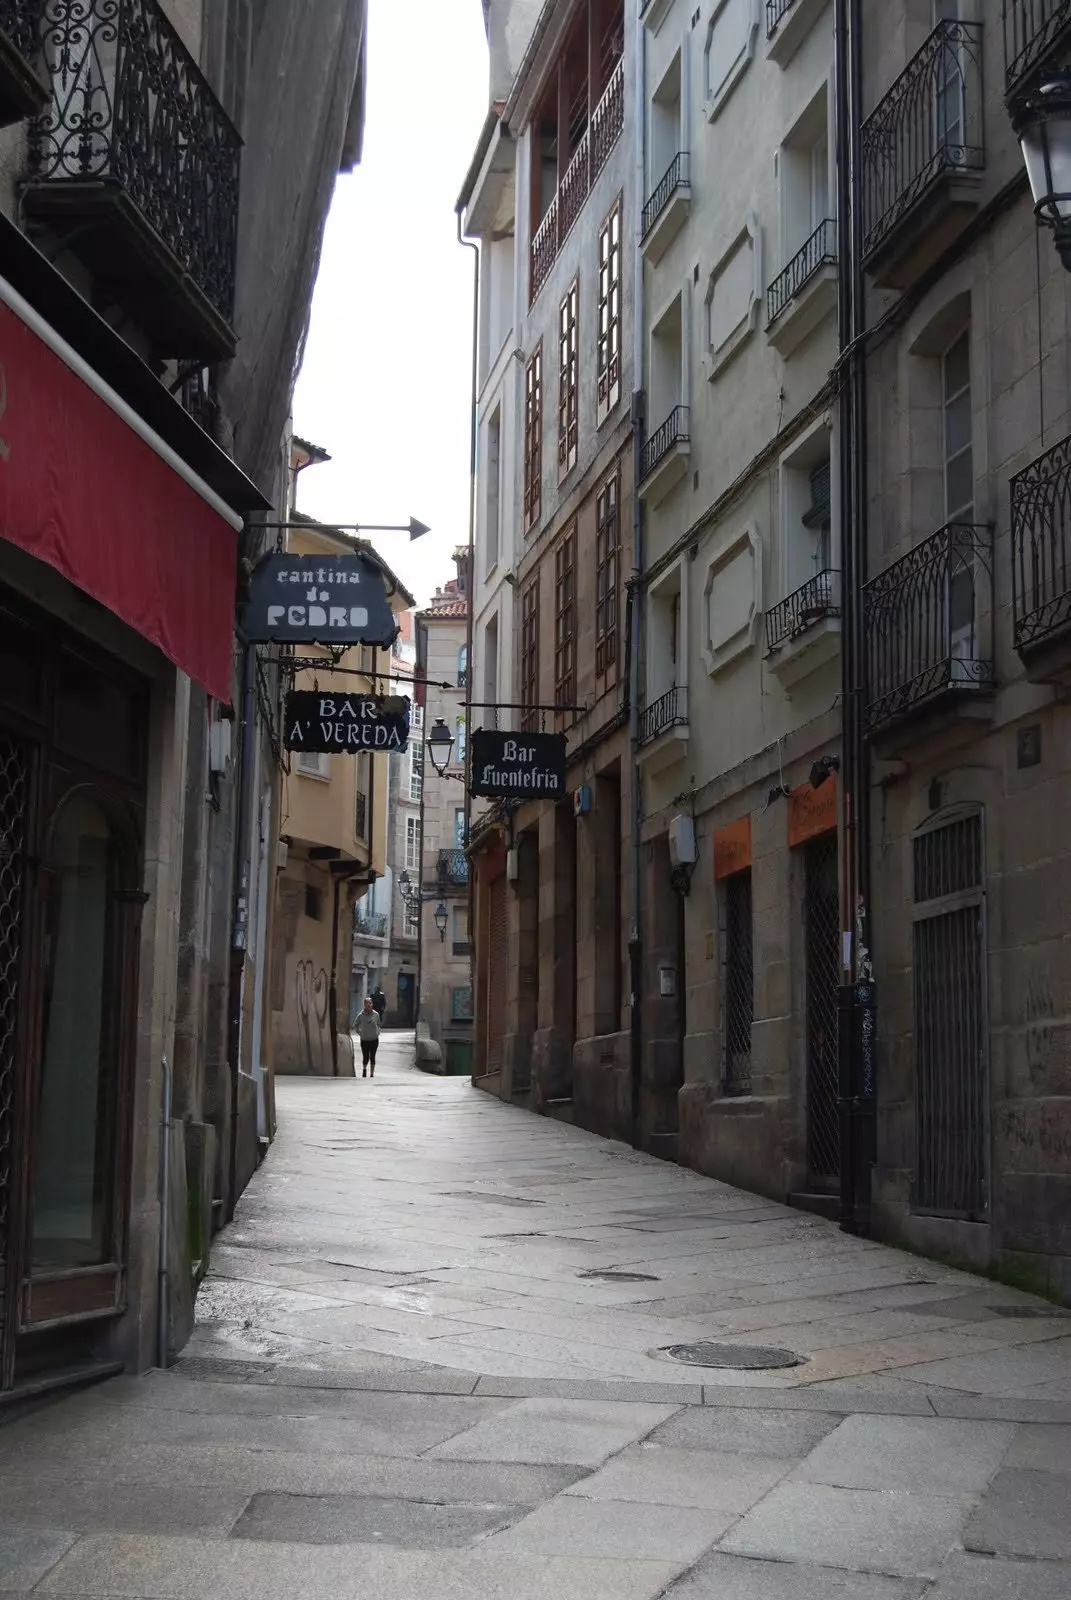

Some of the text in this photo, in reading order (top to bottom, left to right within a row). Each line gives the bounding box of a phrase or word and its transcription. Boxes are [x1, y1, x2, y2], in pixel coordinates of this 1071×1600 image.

[277, 569, 360, 584] cantina
[267, 605, 369, 627] PEDRO
[319, 699, 377, 720] BAR
[319, 722, 402, 746] VEREDA
[502, 740, 537, 762] Bar
